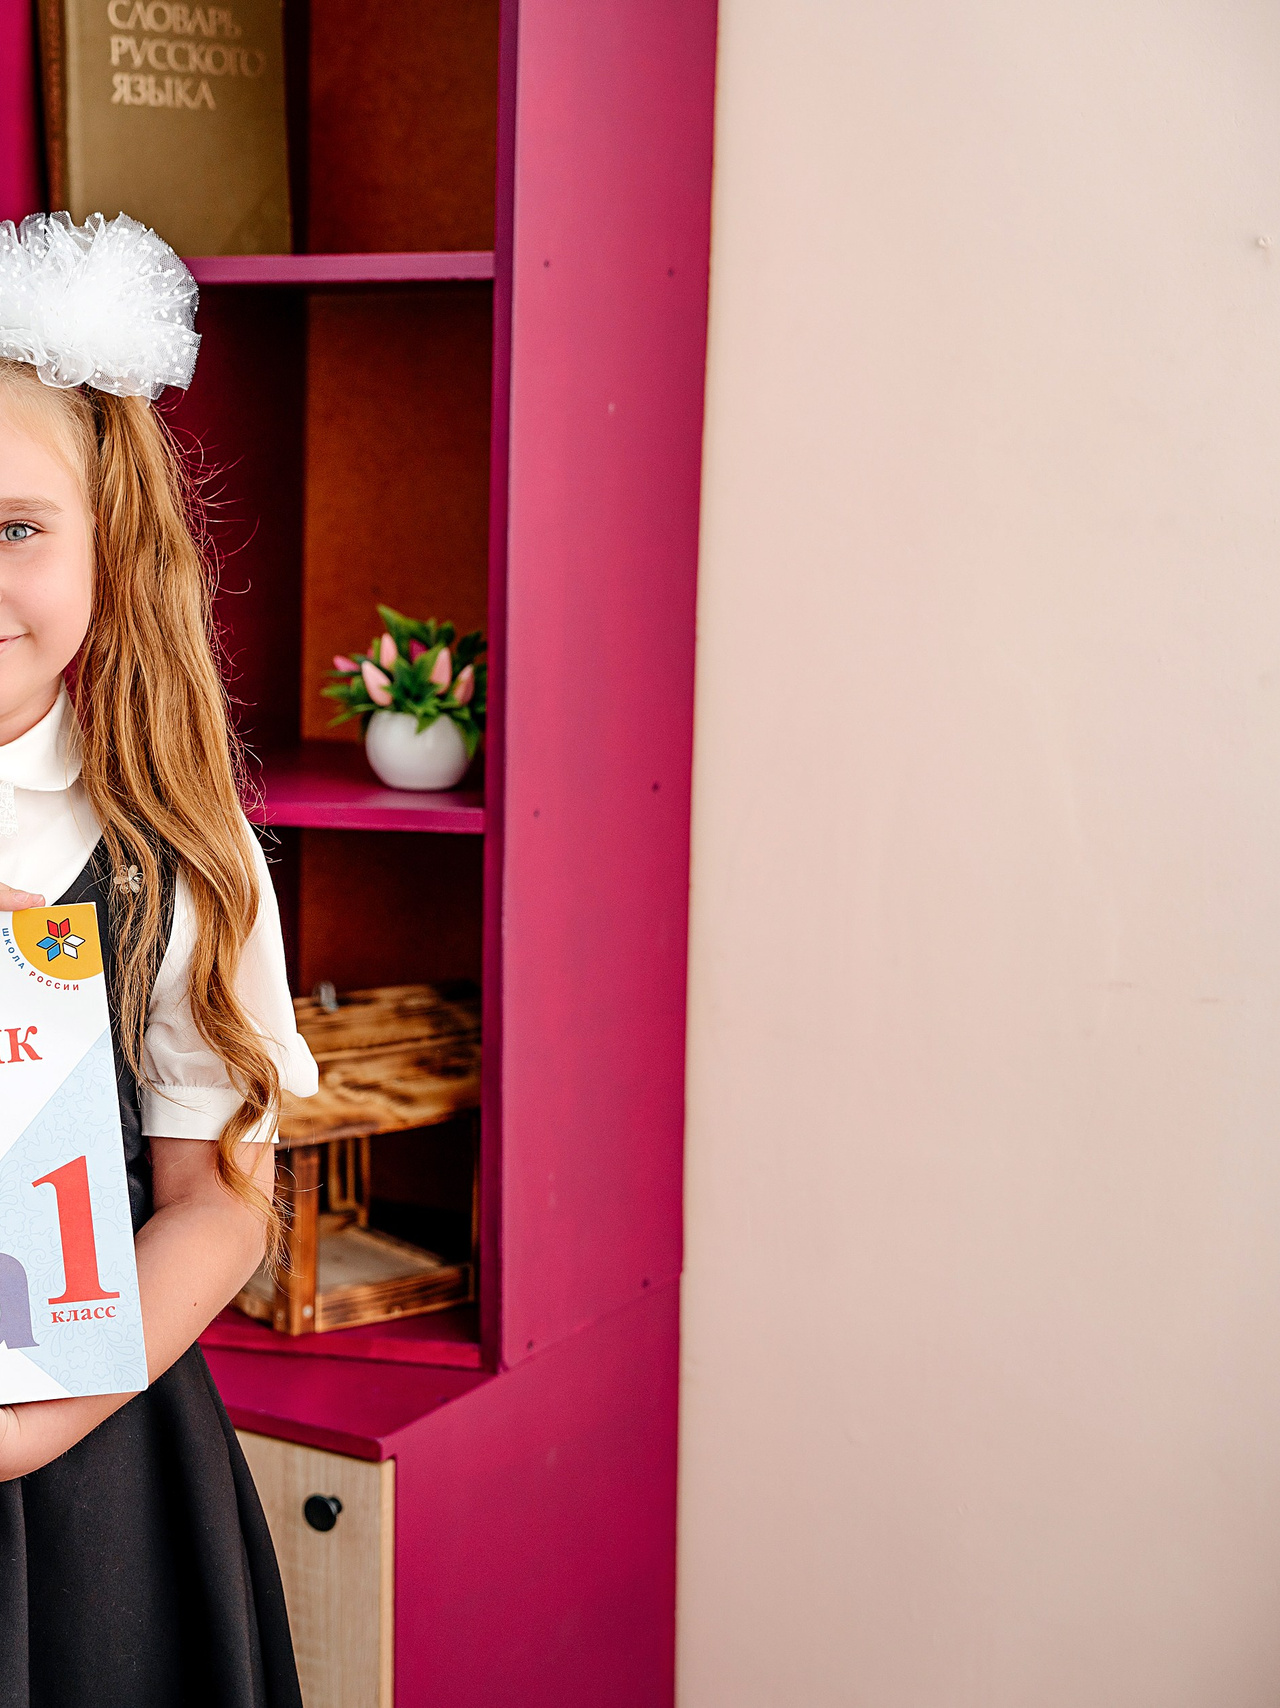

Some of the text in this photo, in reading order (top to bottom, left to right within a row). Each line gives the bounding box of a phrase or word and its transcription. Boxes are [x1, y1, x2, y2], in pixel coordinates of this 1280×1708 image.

[107, 0, 242, 39] СЛОВАРЬ
[109, 35, 266, 77] РУССКОГО
[111, 72, 216, 110] ЯЗЫКА
[1, 927, 80, 991] ШКОЛА РОССИИ
[31, 1155, 120, 1305] 1
[50, 1305, 117, 1324] класс
